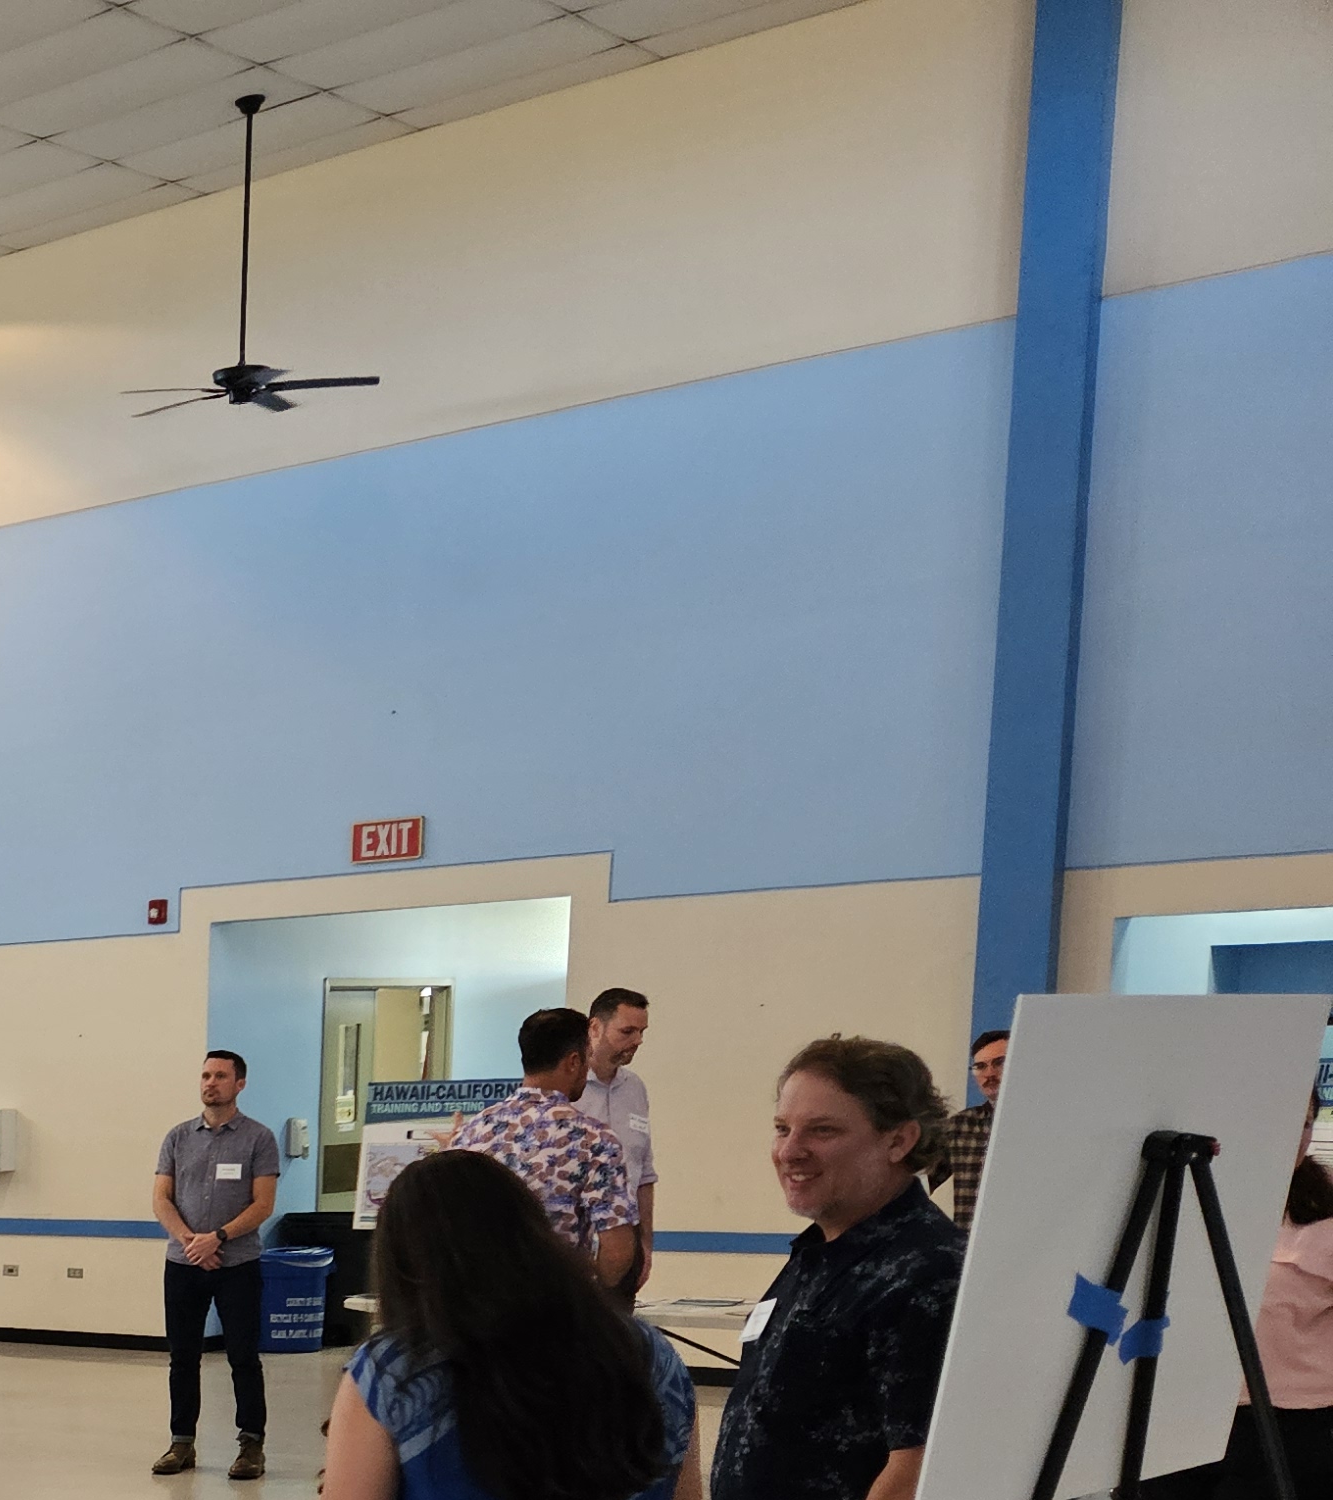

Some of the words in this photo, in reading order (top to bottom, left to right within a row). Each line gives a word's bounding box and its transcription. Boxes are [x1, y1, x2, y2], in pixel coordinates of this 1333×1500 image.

[361, 821, 413, 858] EXIT
[372, 1082, 523, 1101] HAWAII-CALIFORN
[370, 1102, 418, 1114] TRAINING
[418, 1102, 441, 1113] AND
[443, 1101, 484, 1113] TESTING
